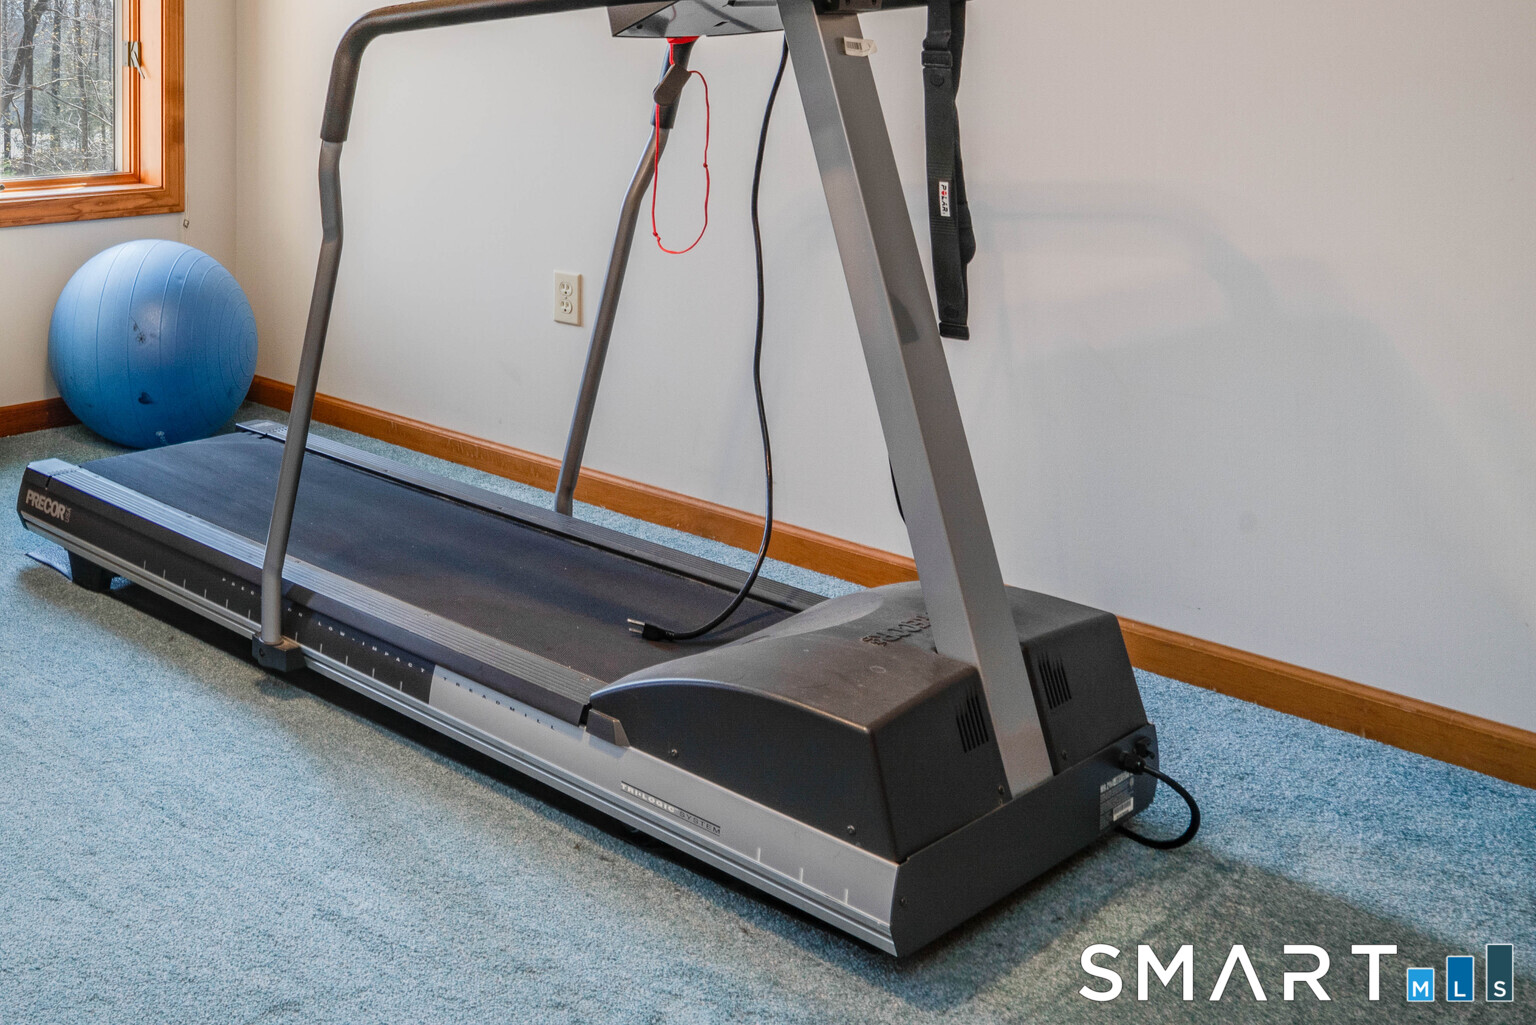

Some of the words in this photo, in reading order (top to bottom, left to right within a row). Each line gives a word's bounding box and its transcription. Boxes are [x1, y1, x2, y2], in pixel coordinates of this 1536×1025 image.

[941, 184, 949, 213] POLAR
[25, 489, 66, 521] PRECOR
[679, 810, 721, 834] SYSTEM
